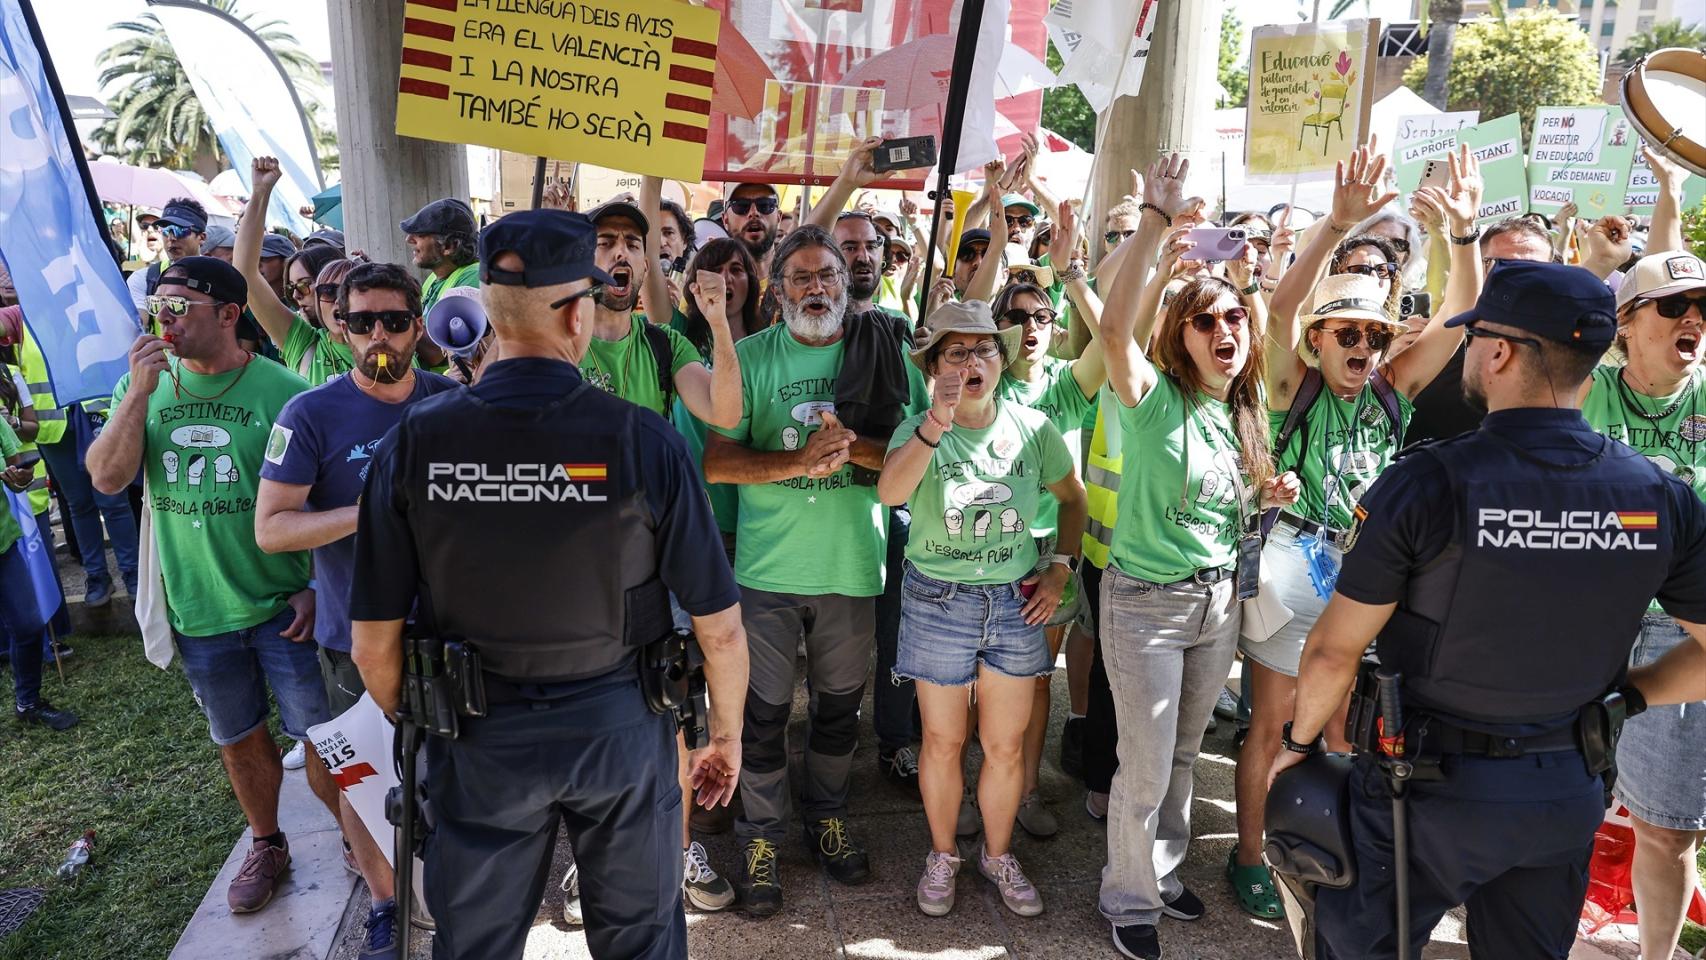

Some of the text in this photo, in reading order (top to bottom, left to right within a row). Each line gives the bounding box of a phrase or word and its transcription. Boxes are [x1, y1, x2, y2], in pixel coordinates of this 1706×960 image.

[496, 0, 576, 23] LLENGUA
[582, 8, 620, 28] DELS
[625, 14, 674, 39] AVIS
[463, 19, 661, 71] ERA EL VALENCIÀ
[459, 55, 619, 98] I LA NOSTRA
[453, 91, 651, 146] TAMBÉ HO SERÀ
[1542, 117, 1560, 128] PER
[1406, 138, 1455, 160] LA PROFE
[1538, 134, 1580, 145] INVERTIR
[1535, 150, 1548, 161] EN
[1551, 170, 1612, 182] ENS DEMANEU
[1478, 200, 1518, 218] UCANT
[778, 378, 836, 402] ESTIM
[158, 402, 253, 427] ESTIMEM
[428, 462, 571, 482] POLICIA
[427, 483, 607, 502] NACIONAL
[151, 493, 199, 516] 'ESCOLA
[1478, 508, 1624, 530] POLICIA
[1477, 528, 1657, 551] NACIONAL
